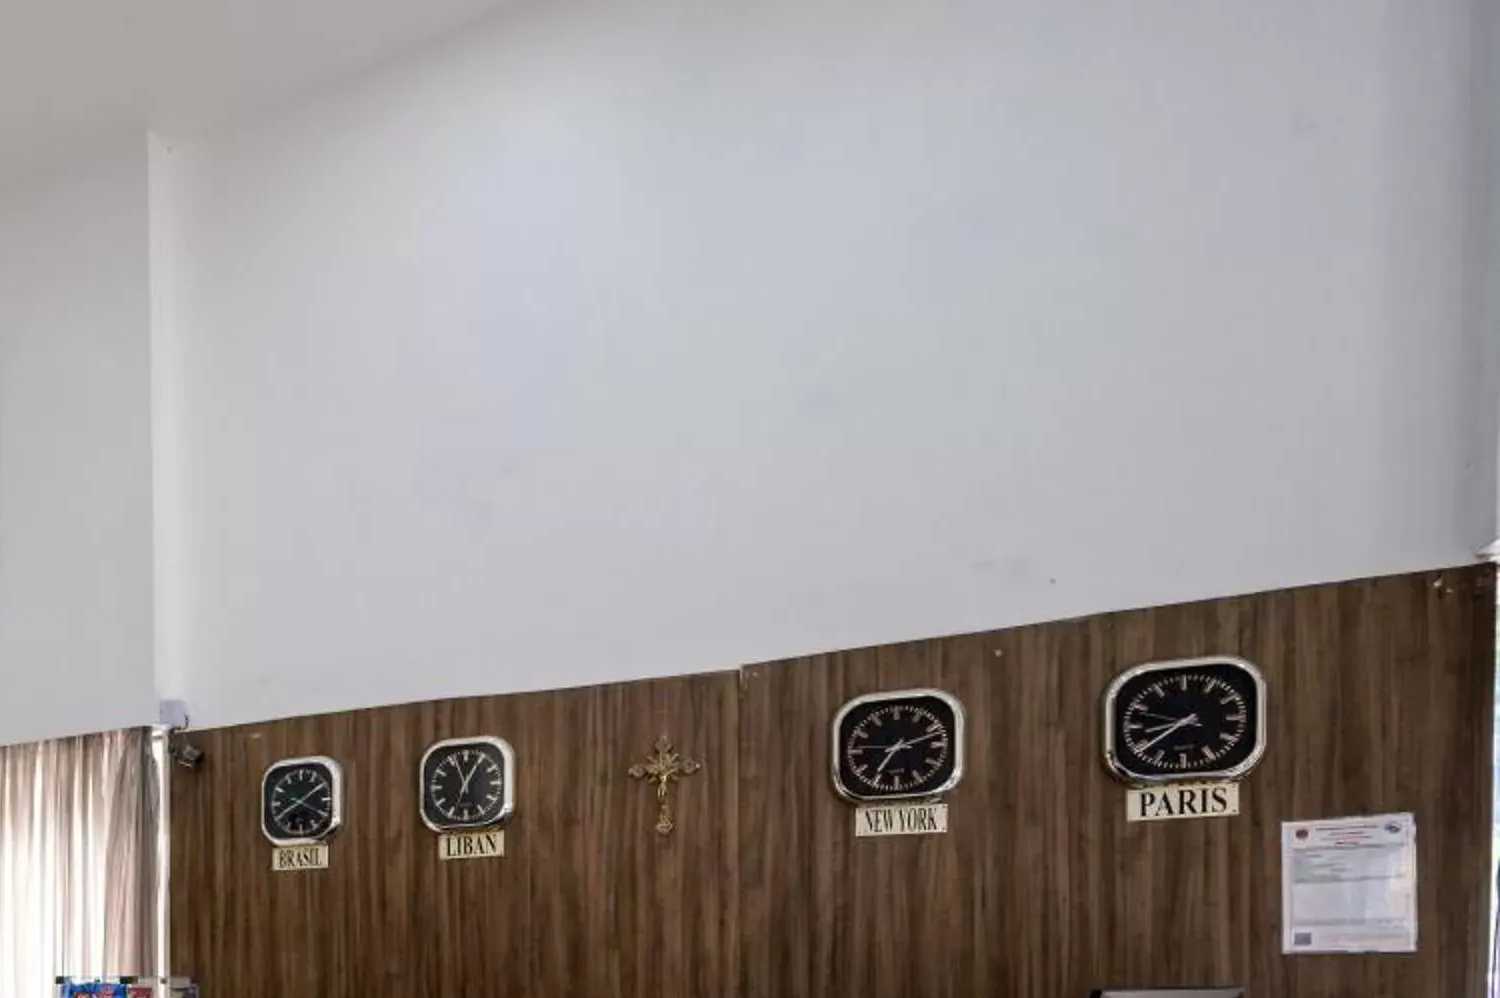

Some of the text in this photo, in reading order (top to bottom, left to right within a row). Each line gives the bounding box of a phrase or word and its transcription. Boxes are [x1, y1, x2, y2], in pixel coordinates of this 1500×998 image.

[1140, 787, 1228, 817] PARIS
[865, 807, 938, 833] NEW YORK
[446, 833, 498, 857] LIBAN
